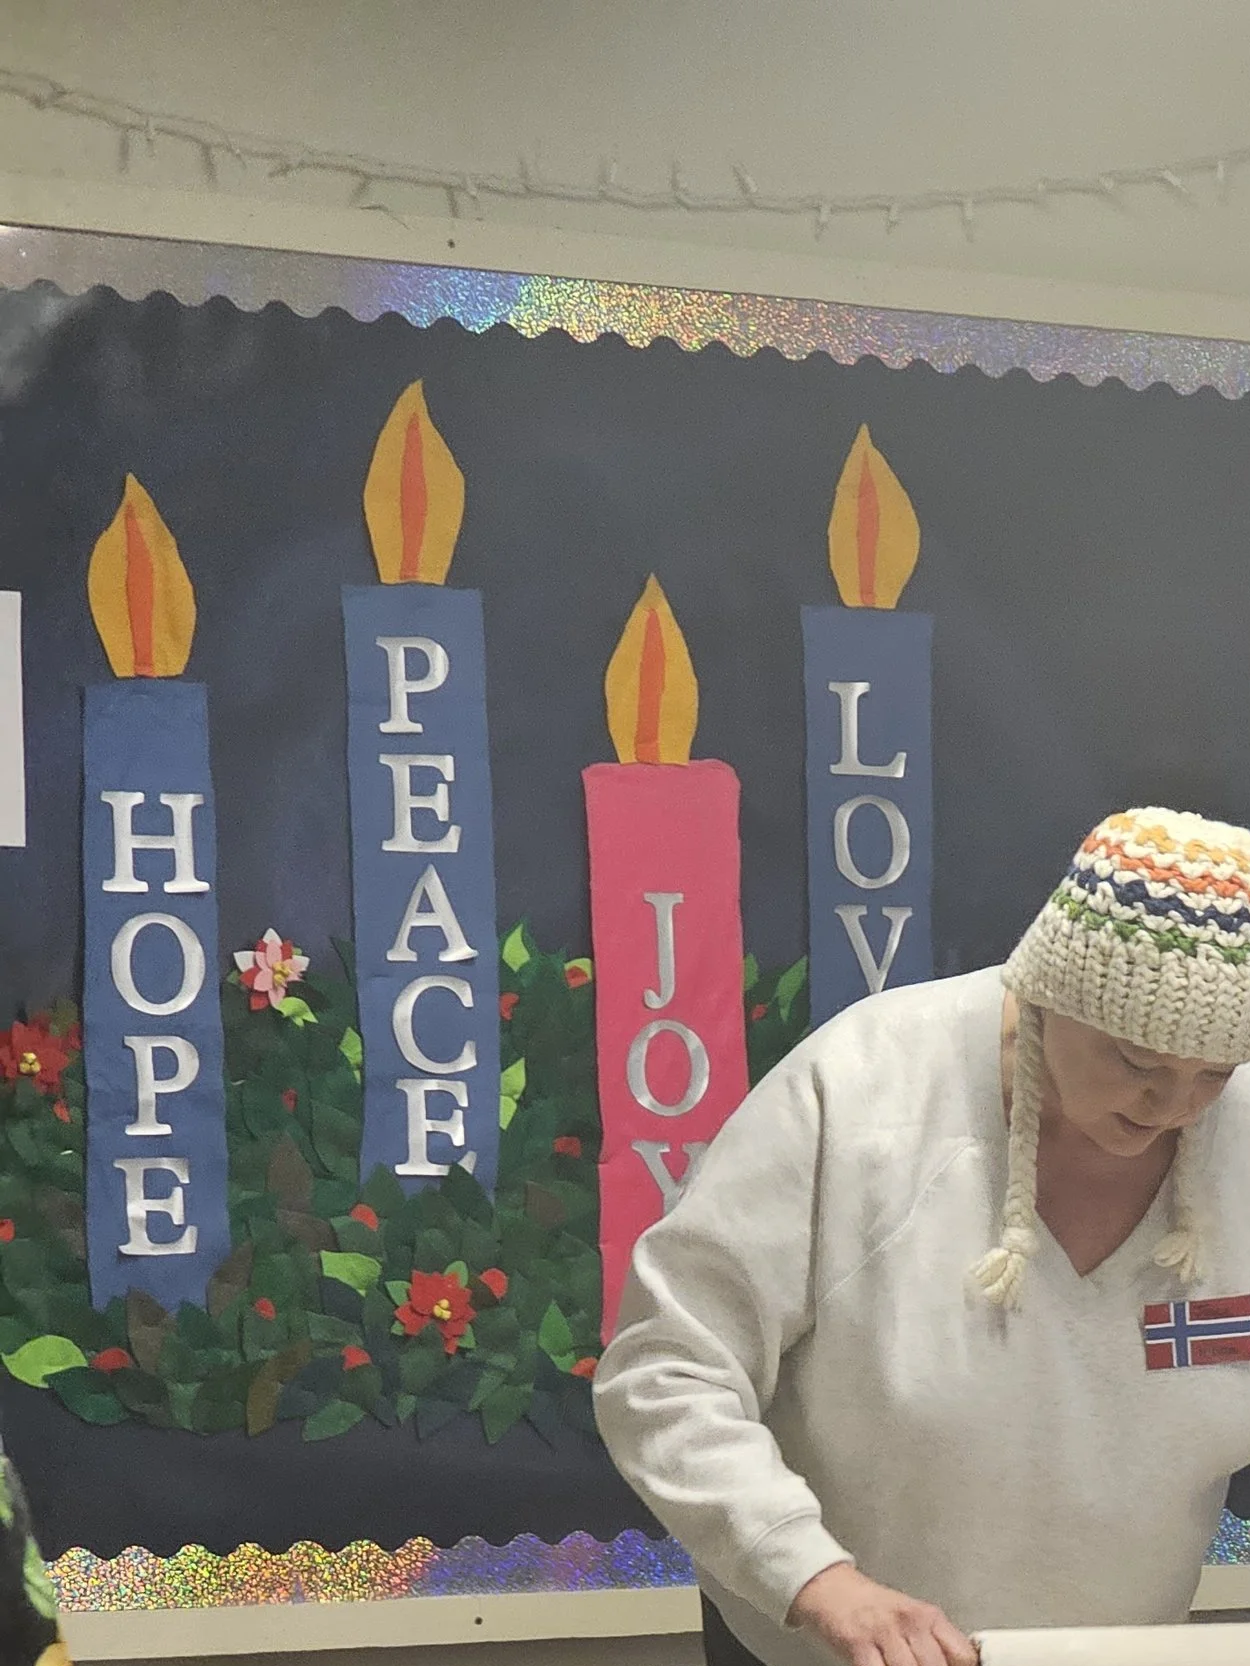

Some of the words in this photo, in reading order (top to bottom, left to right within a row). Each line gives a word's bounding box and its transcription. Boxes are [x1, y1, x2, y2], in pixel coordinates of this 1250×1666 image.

[101, 790, 210, 1256] HOPE
[376, 636, 479, 1177] PEACE
[827, 681, 912, 993] LOV
[626, 892, 711, 1217] JOY
